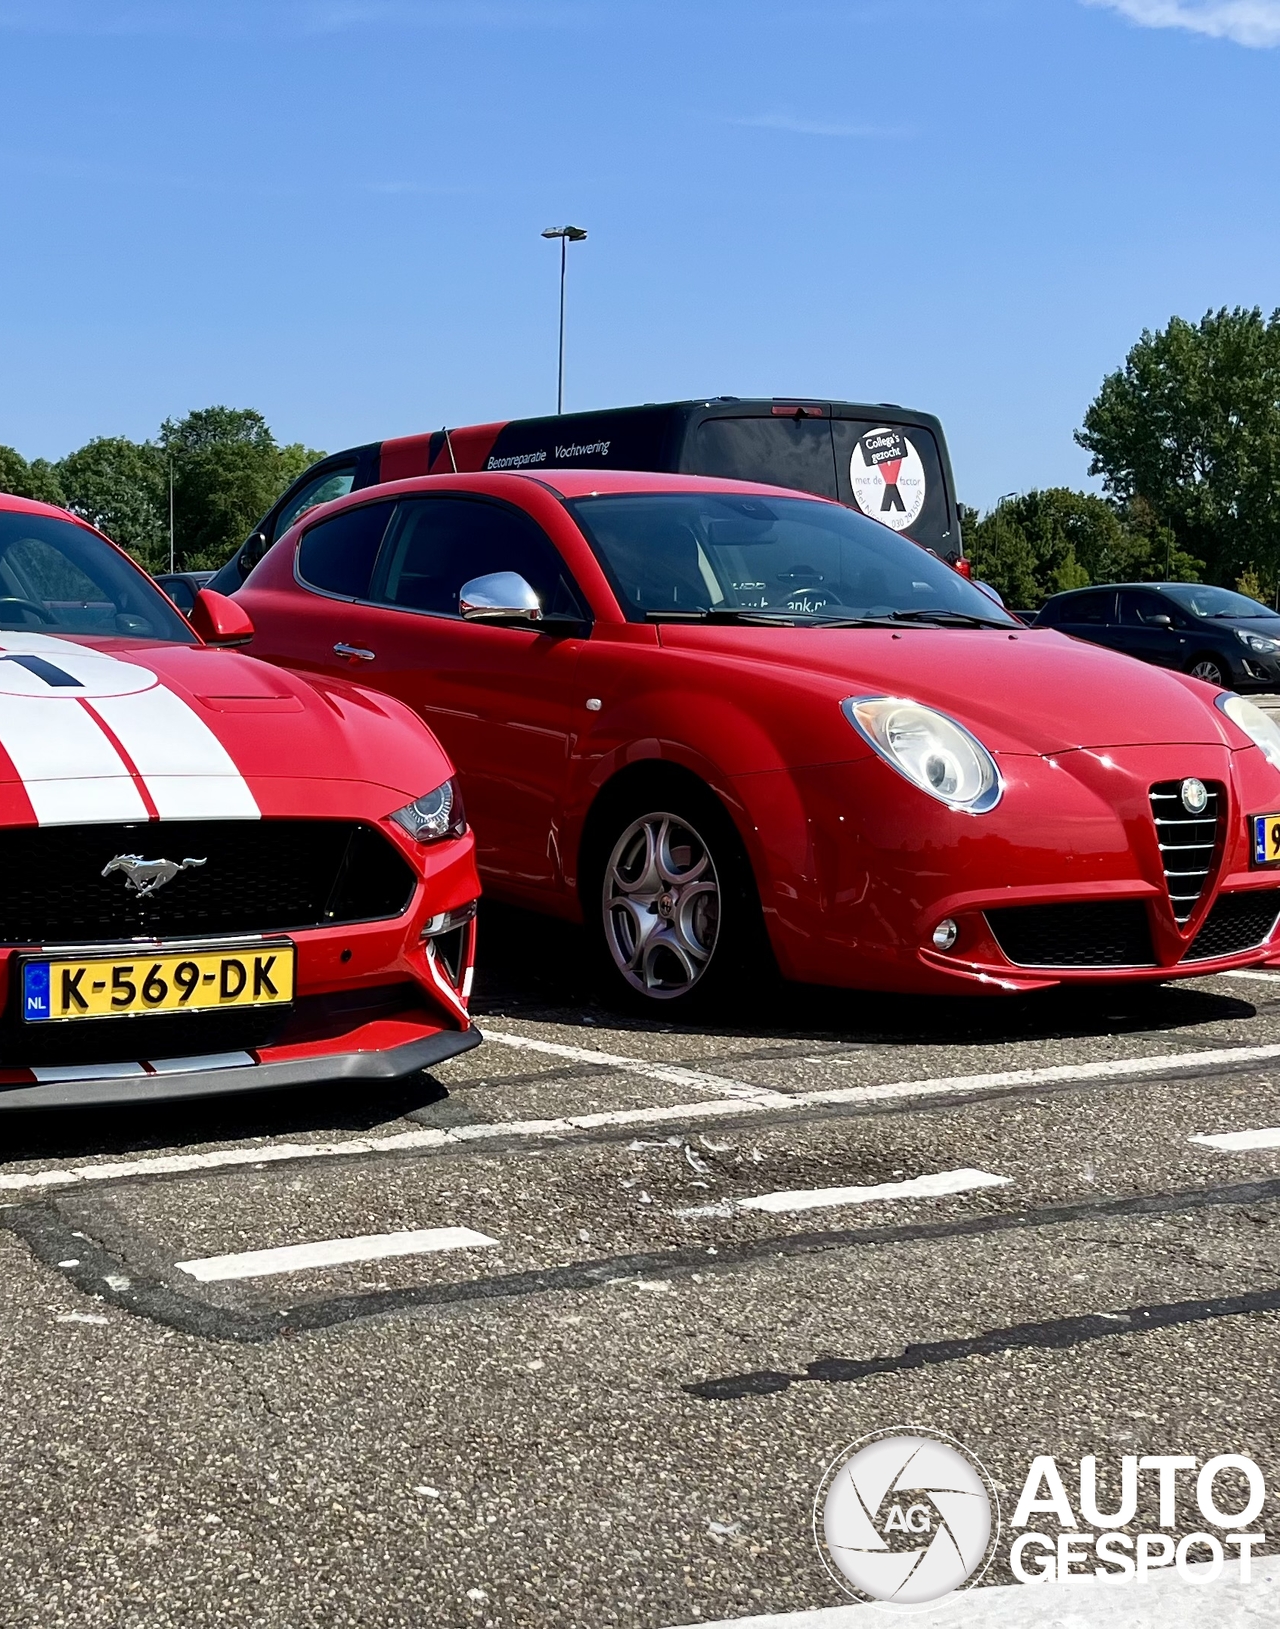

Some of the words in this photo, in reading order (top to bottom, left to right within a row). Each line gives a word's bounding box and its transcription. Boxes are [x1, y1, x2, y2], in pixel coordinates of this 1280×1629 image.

[865, 433, 900, 449] Collega's
[487, 449, 547, 469] Betonreparatie
[555, 440, 611, 459] Vochtwering
[872, 447, 901, 464] gezocht
[873, 476, 882, 485] de
[27, 996, 47, 1010] NL
[61, 955, 279, 1011] K-569-DK
